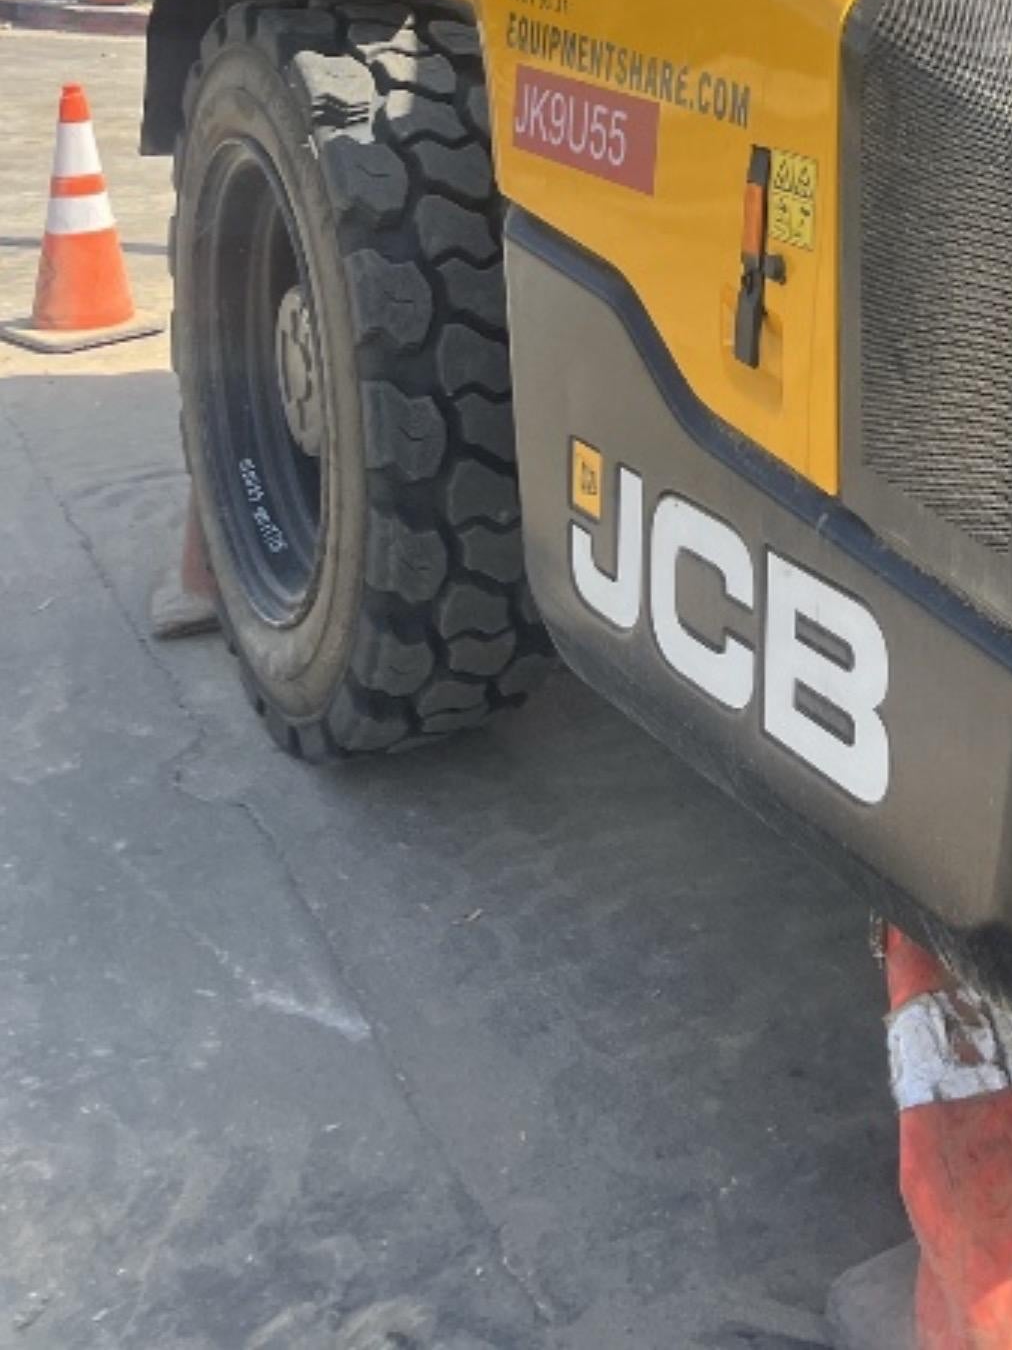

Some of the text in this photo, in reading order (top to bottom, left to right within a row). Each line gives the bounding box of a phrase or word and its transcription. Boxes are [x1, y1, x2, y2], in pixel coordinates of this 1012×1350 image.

[506, 11, 750, 130] EQUIPMENTSHARE.COM
[515, 84, 628, 166] JK9U55
[570, 465, 890, 805] JCB
